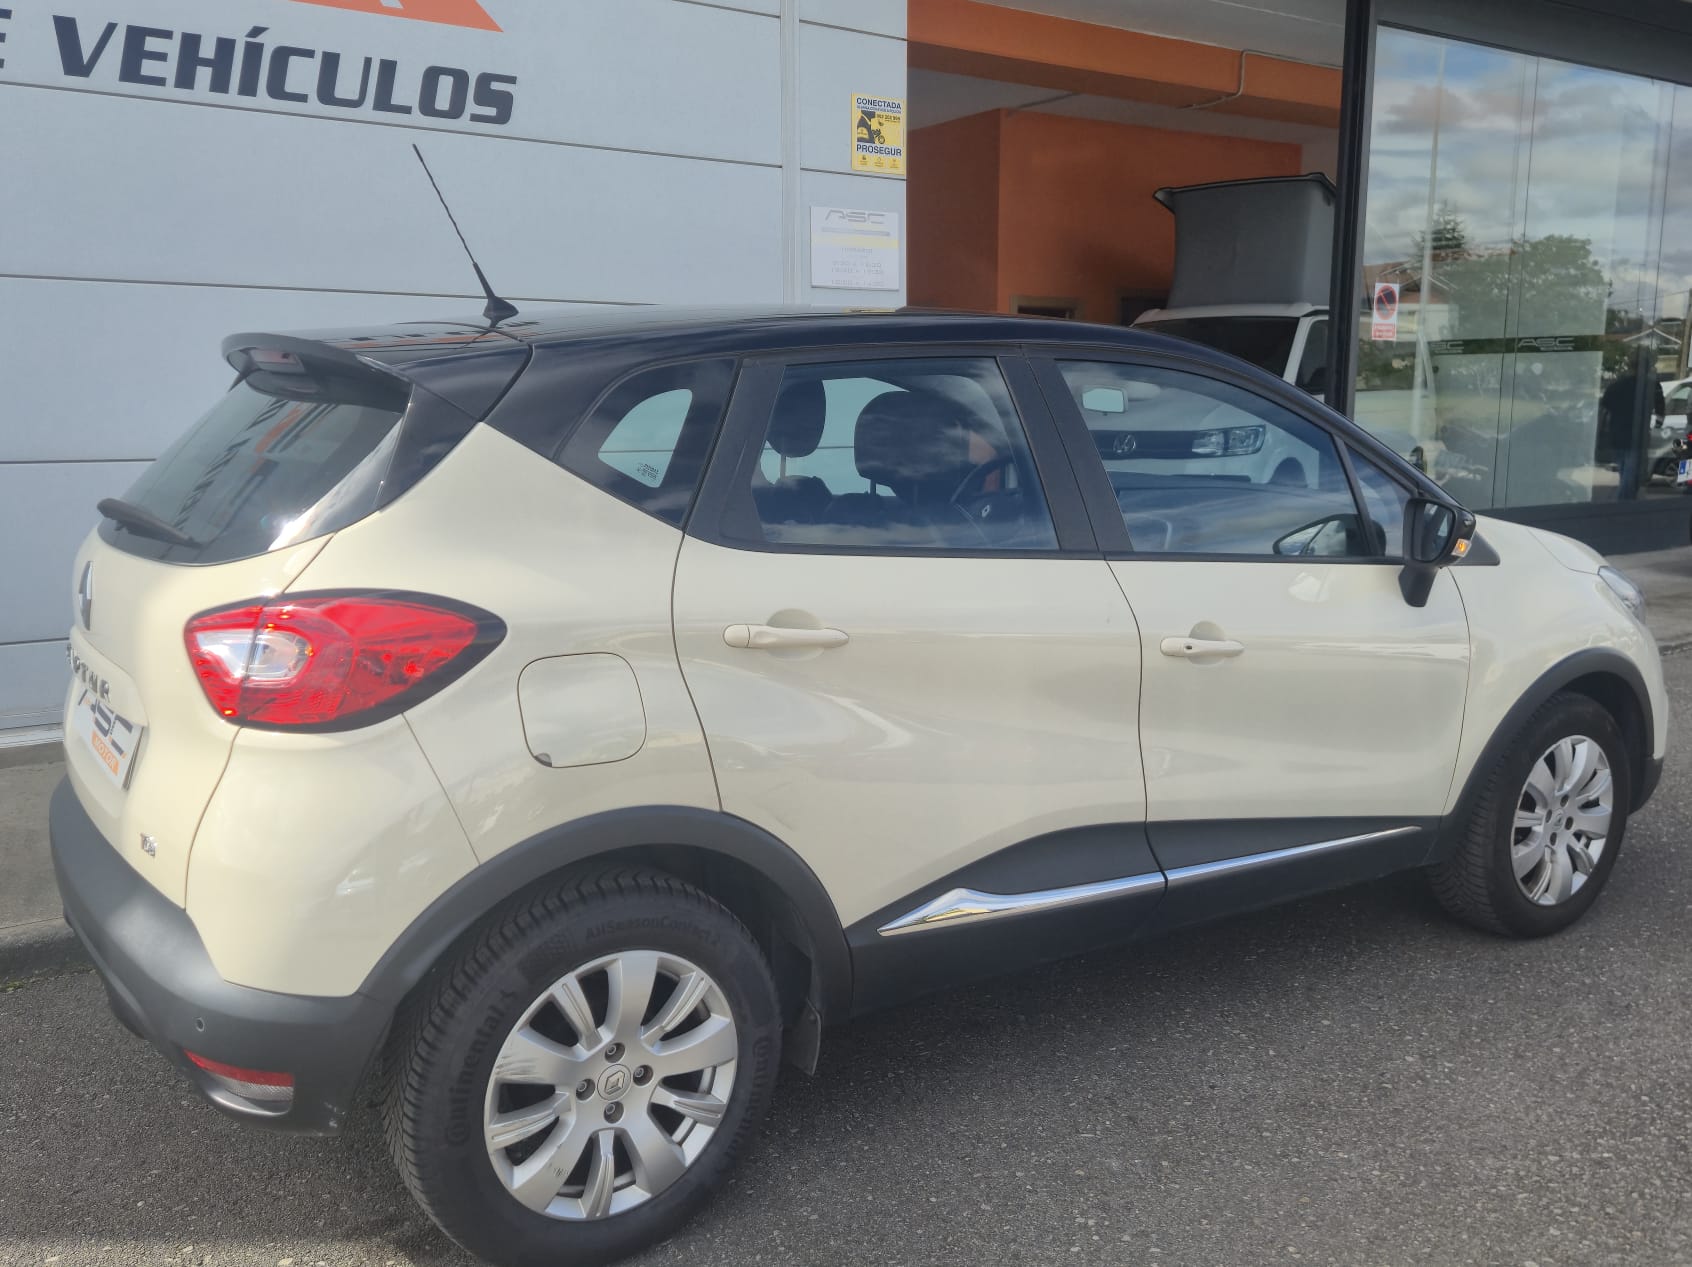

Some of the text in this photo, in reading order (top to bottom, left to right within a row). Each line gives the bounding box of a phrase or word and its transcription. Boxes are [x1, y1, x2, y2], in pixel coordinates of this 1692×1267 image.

[52, 15, 518, 125] VEHÍCULOS
[856, 97, 902, 109] CONECTADA
[856, 144, 902, 156] PROSEGUR
